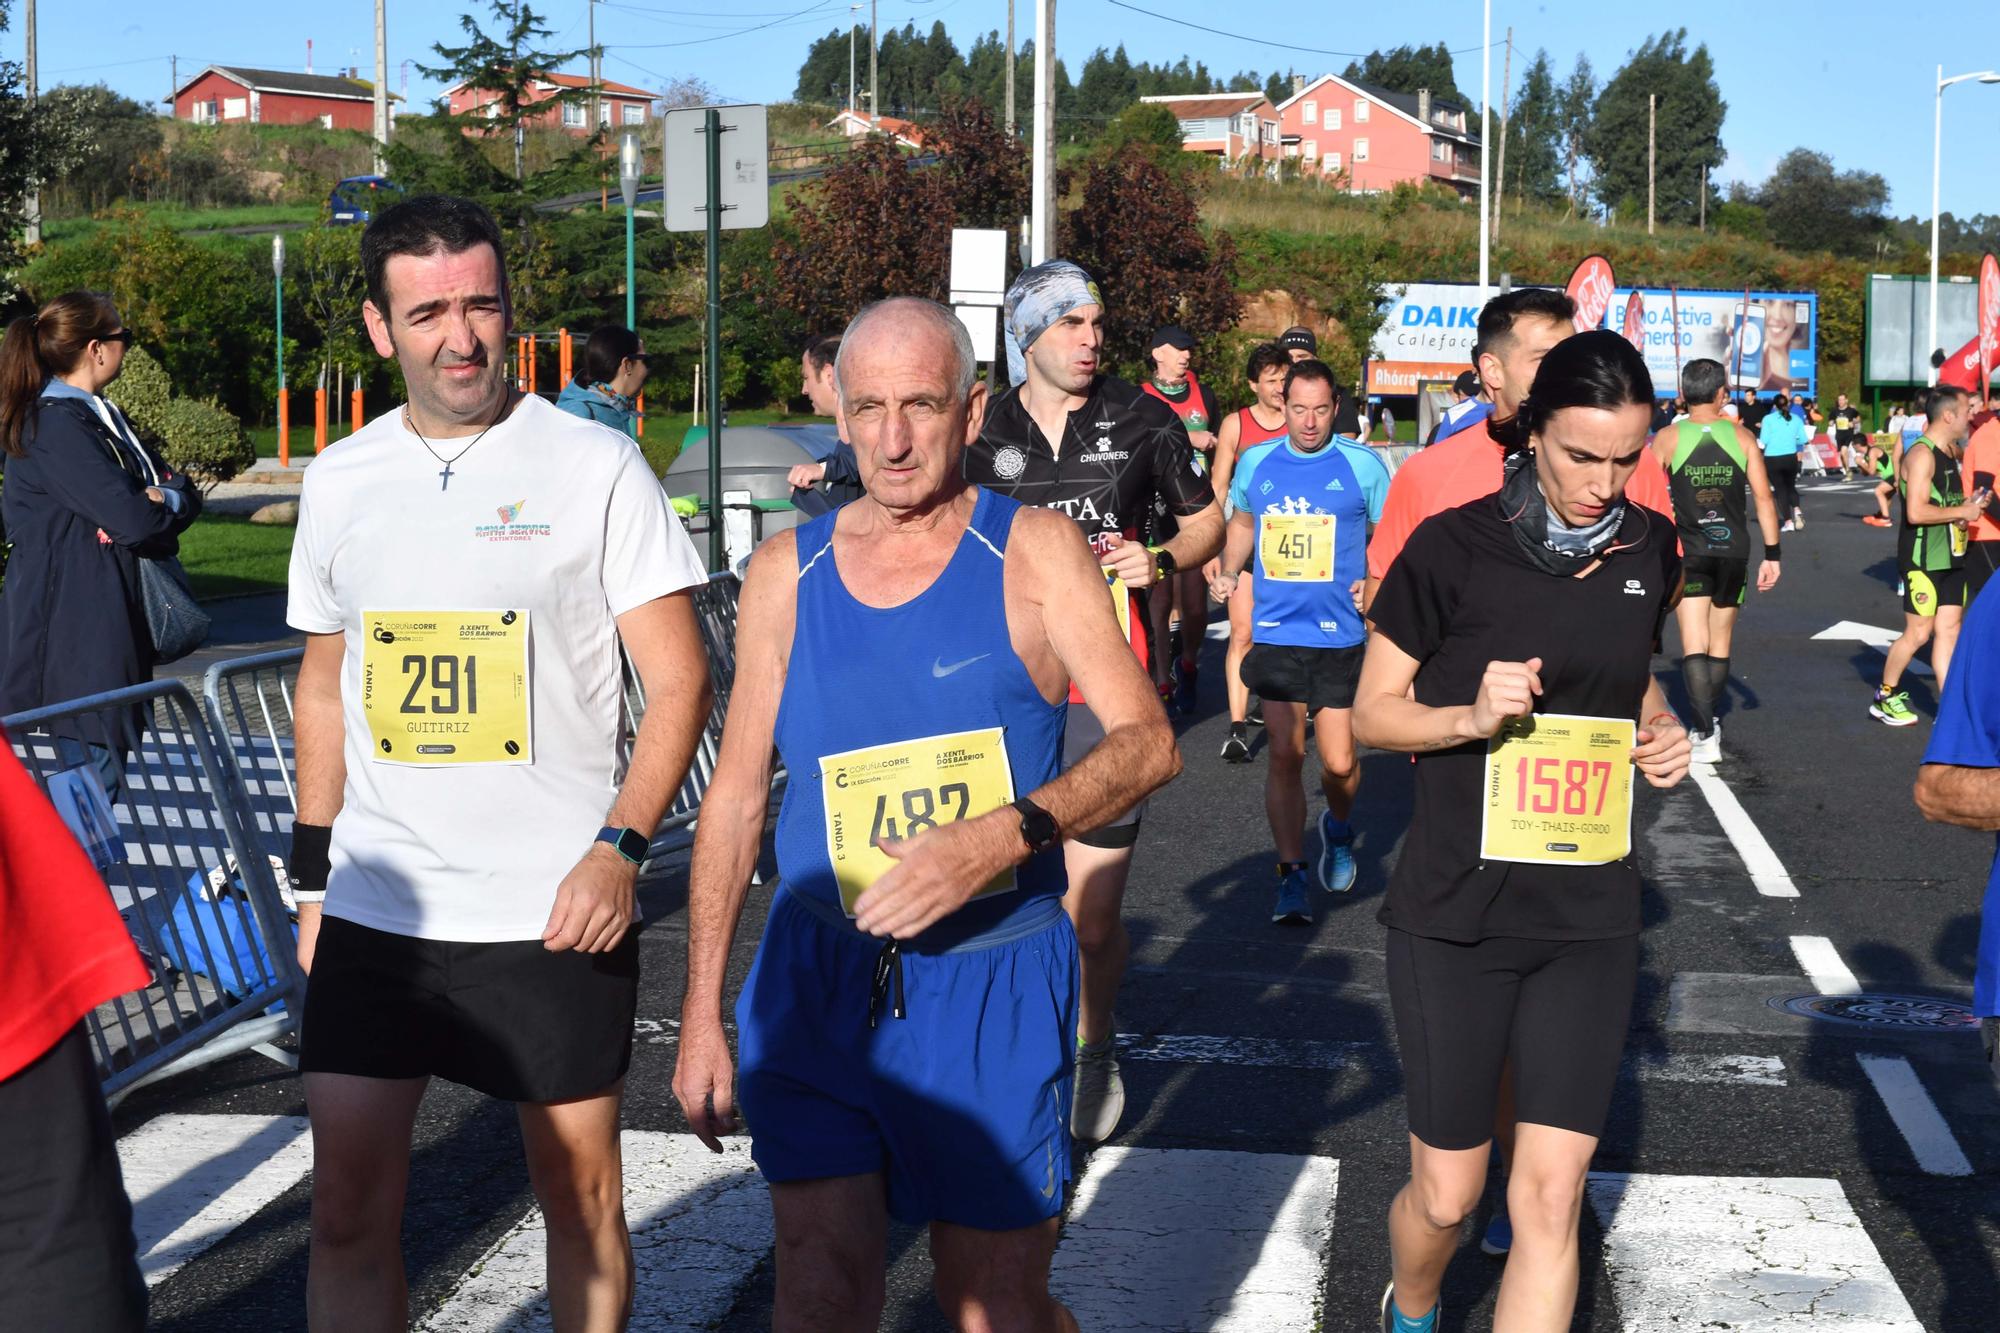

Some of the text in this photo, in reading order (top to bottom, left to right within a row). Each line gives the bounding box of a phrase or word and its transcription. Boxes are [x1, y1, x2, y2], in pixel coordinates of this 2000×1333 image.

[1080, 451, 1129, 463] CHUVONERS
[1684, 462, 1733, 477] Running
[1690, 475, 1732, 487] Oleiros
[1277, 533, 1313, 560] 451
[365, 662, 374, 701] TANDA
[399, 654, 478, 715] 291
[406, 722, 470, 733] GUITIRIZ
[936, 752, 985, 766] DOS BARRIOS
[943, 749, 966, 759] XENTE
[849, 756, 911, 775] CORUÑACORRE
[857, 776, 882, 786] EDICIÓN
[1492, 763, 1501, 799] TANDA
[1516, 756, 1613, 817] 1587
[869, 782, 971, 848] 482
[1511, 819, 1611, 834] TOY-THAIS-GORDO
[833, 811, 846, 861] TANDA 3
